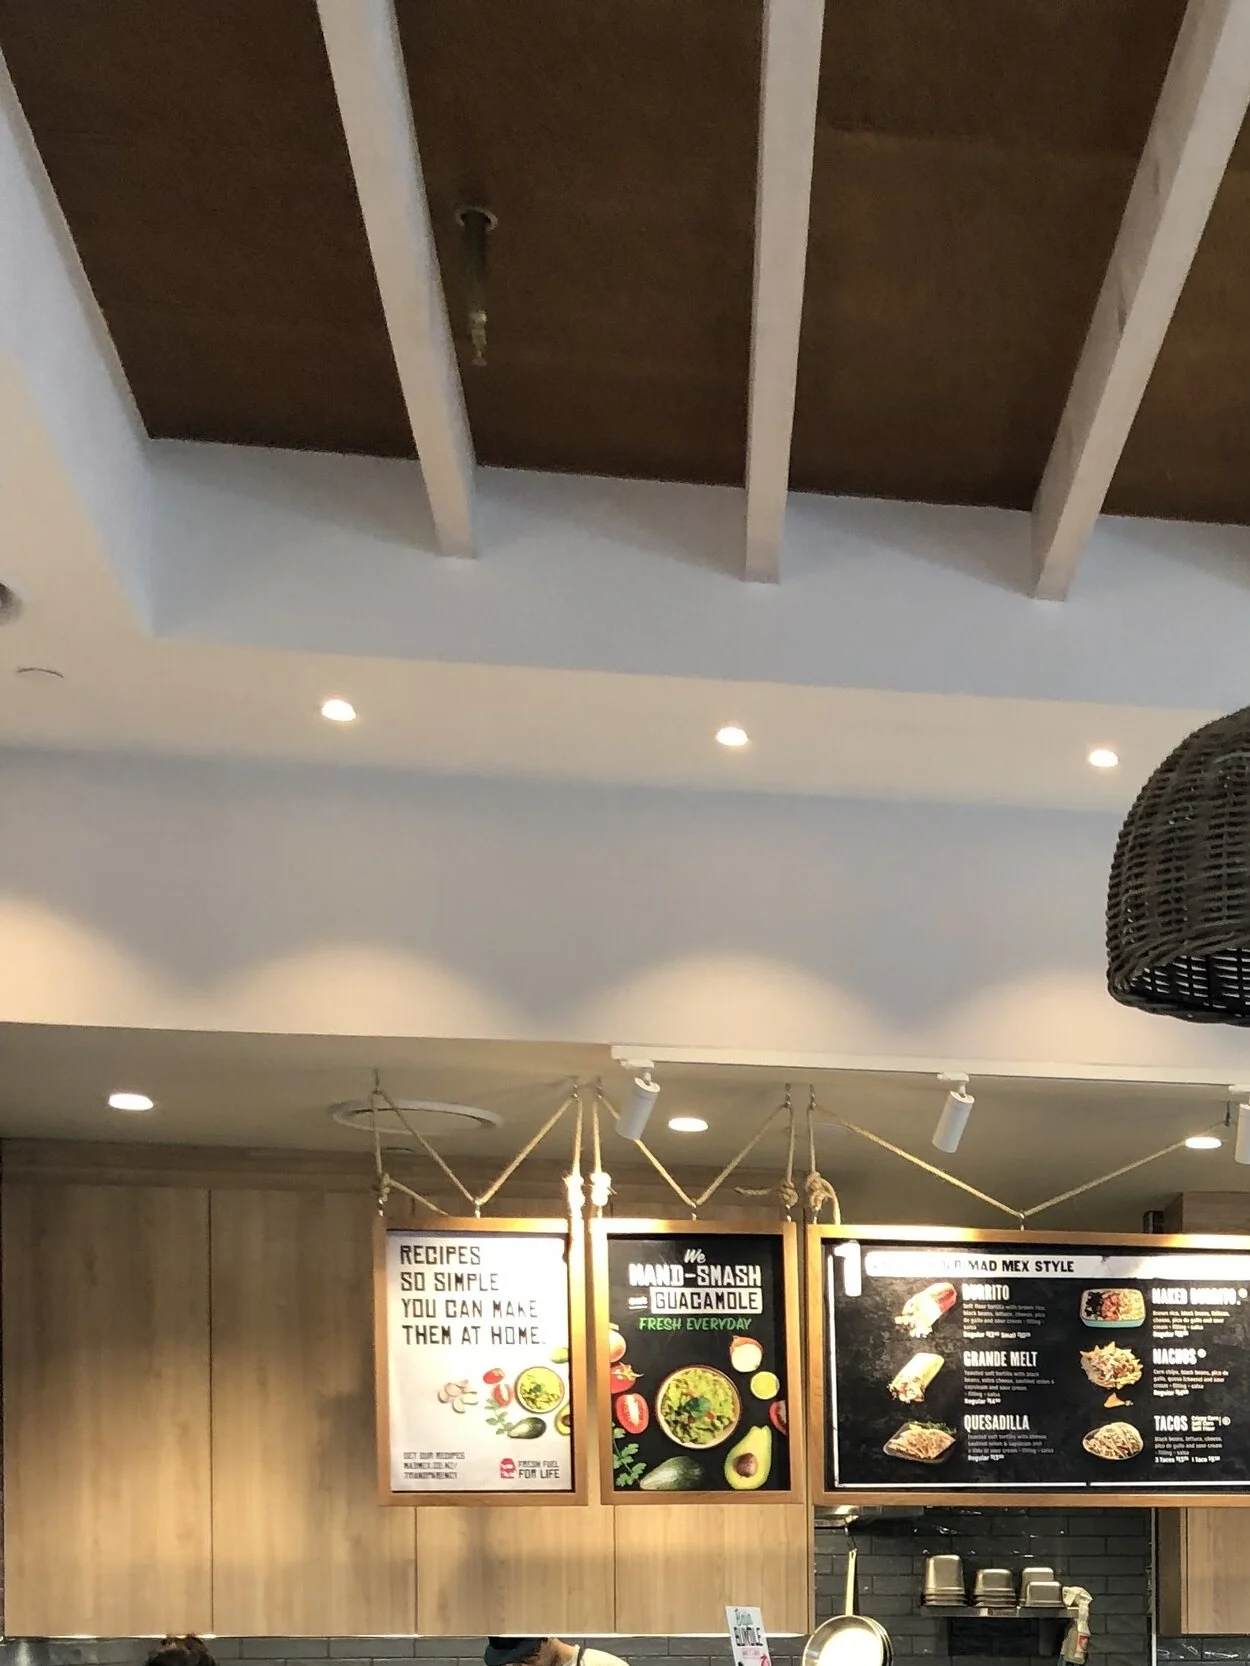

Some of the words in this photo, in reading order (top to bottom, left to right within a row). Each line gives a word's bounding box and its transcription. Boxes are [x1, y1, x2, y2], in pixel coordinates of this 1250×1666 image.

[400, 1245, 481, 1265] RECIPES
[684, 1248, 706, 1264] We
[834, 1240, 861, 1296] 1
[968, 1260, 997, 1272] MAD
[1002, 1260, 1029, 1272] MEX
[1035, 1261, 1074, 1273] STYLE
[400, 1272, 425, 1291] SO
[434, 1272, 499, 1291] SIMPLE
[655, 1292, 758, 1310] GUACAMOLE
[962, 1283, 1009, 1301] BURRITO
[401, 1298, 436, 1318] YOU
[445, 1300, 482, 1318] CAN
[492, 1300, 538, 1318] MAKE
[639, 1317, 681, 1330] FRESH
[686, 1317, 751, 1330] EVERYDAY
[402, 1325, 452, 1345] THEM
[461, 1326, 481, 1345] AT
[963, 1351, 1007, 1367] GRANDE
[1010, 1351, 1038, 1367] MELT
[1153, 1348, 1197, 1365] NACHOS
[964, 1414, 1030, 1433] QUESADILLA
[1154, 1415, 1188, 1431] TACOS
[519, 1469, 536, 1479] FOR
[540, 1469, 560, 1479] LIFE
